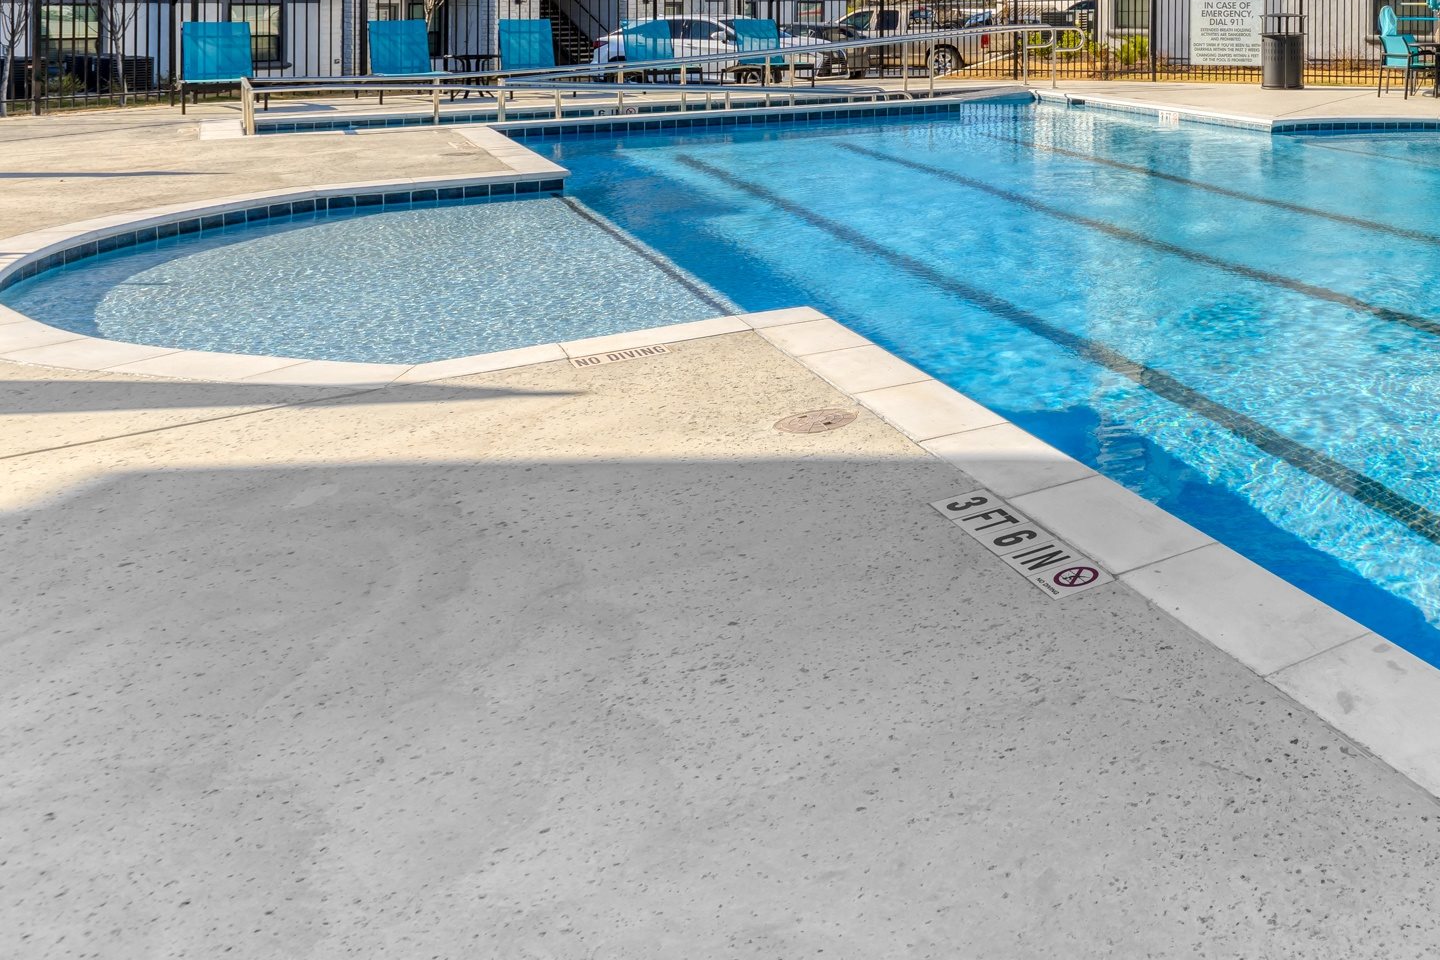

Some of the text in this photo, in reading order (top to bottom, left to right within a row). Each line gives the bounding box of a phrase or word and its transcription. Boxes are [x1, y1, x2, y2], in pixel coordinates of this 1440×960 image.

[1201, 10, 1254, 19] EMERGENCY,
[1209, 18, 1244, 26] DIAL 911
[574, 345, 666, 368] NO DIVING
[946, 496, 1071, 571] 3 FT 6 IN
[1042, 582, 1060, 595] DIVING
